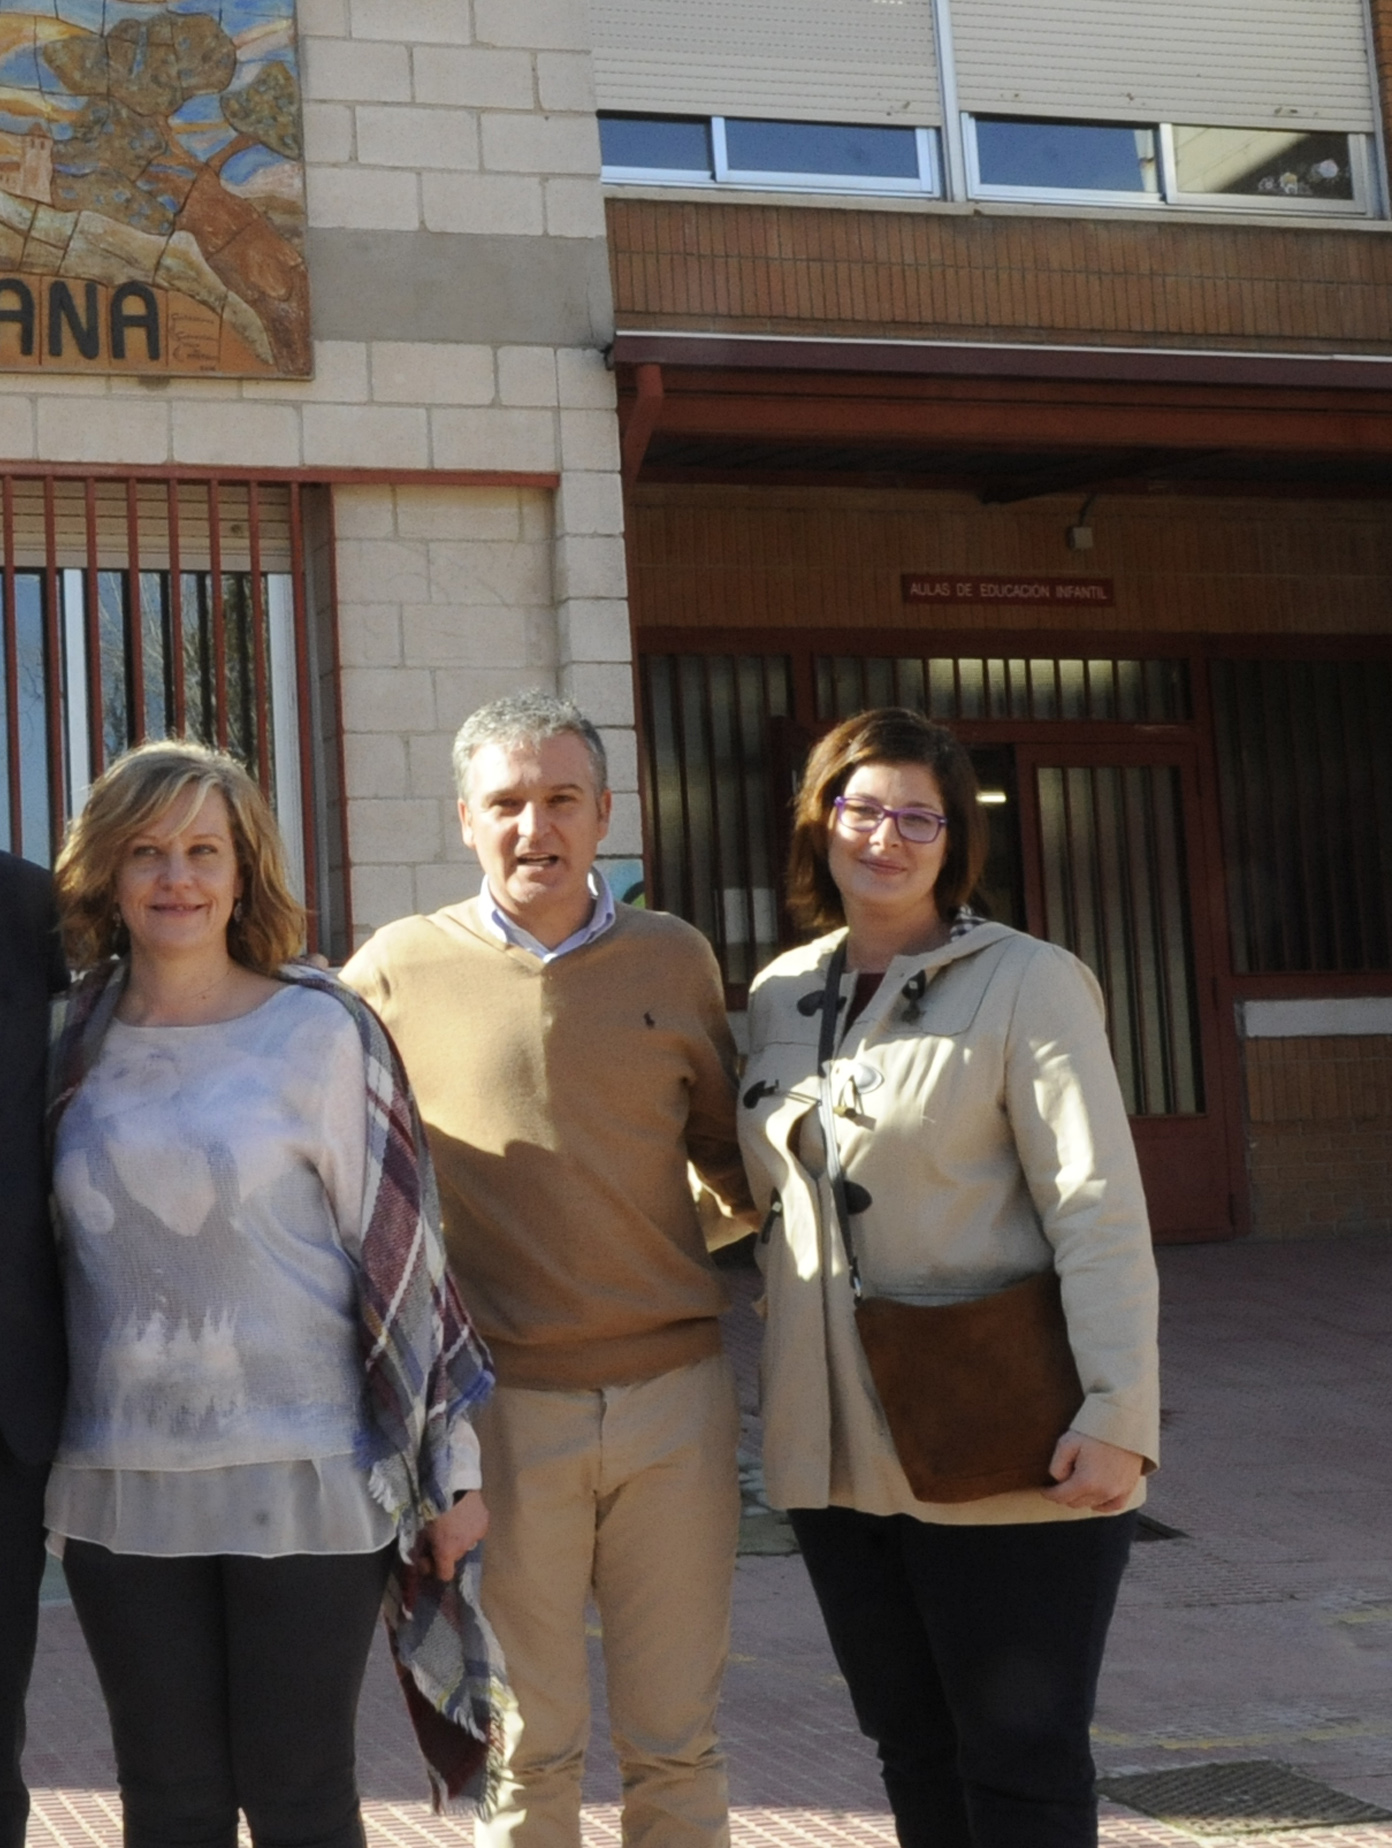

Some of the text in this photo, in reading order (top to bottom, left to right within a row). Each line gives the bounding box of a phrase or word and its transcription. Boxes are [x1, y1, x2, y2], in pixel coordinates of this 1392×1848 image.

[910, 582, 950, 597] AULAS
[957, 583, 973, 597] DE
[1055, 585, 1107, 600] INFANTIL
